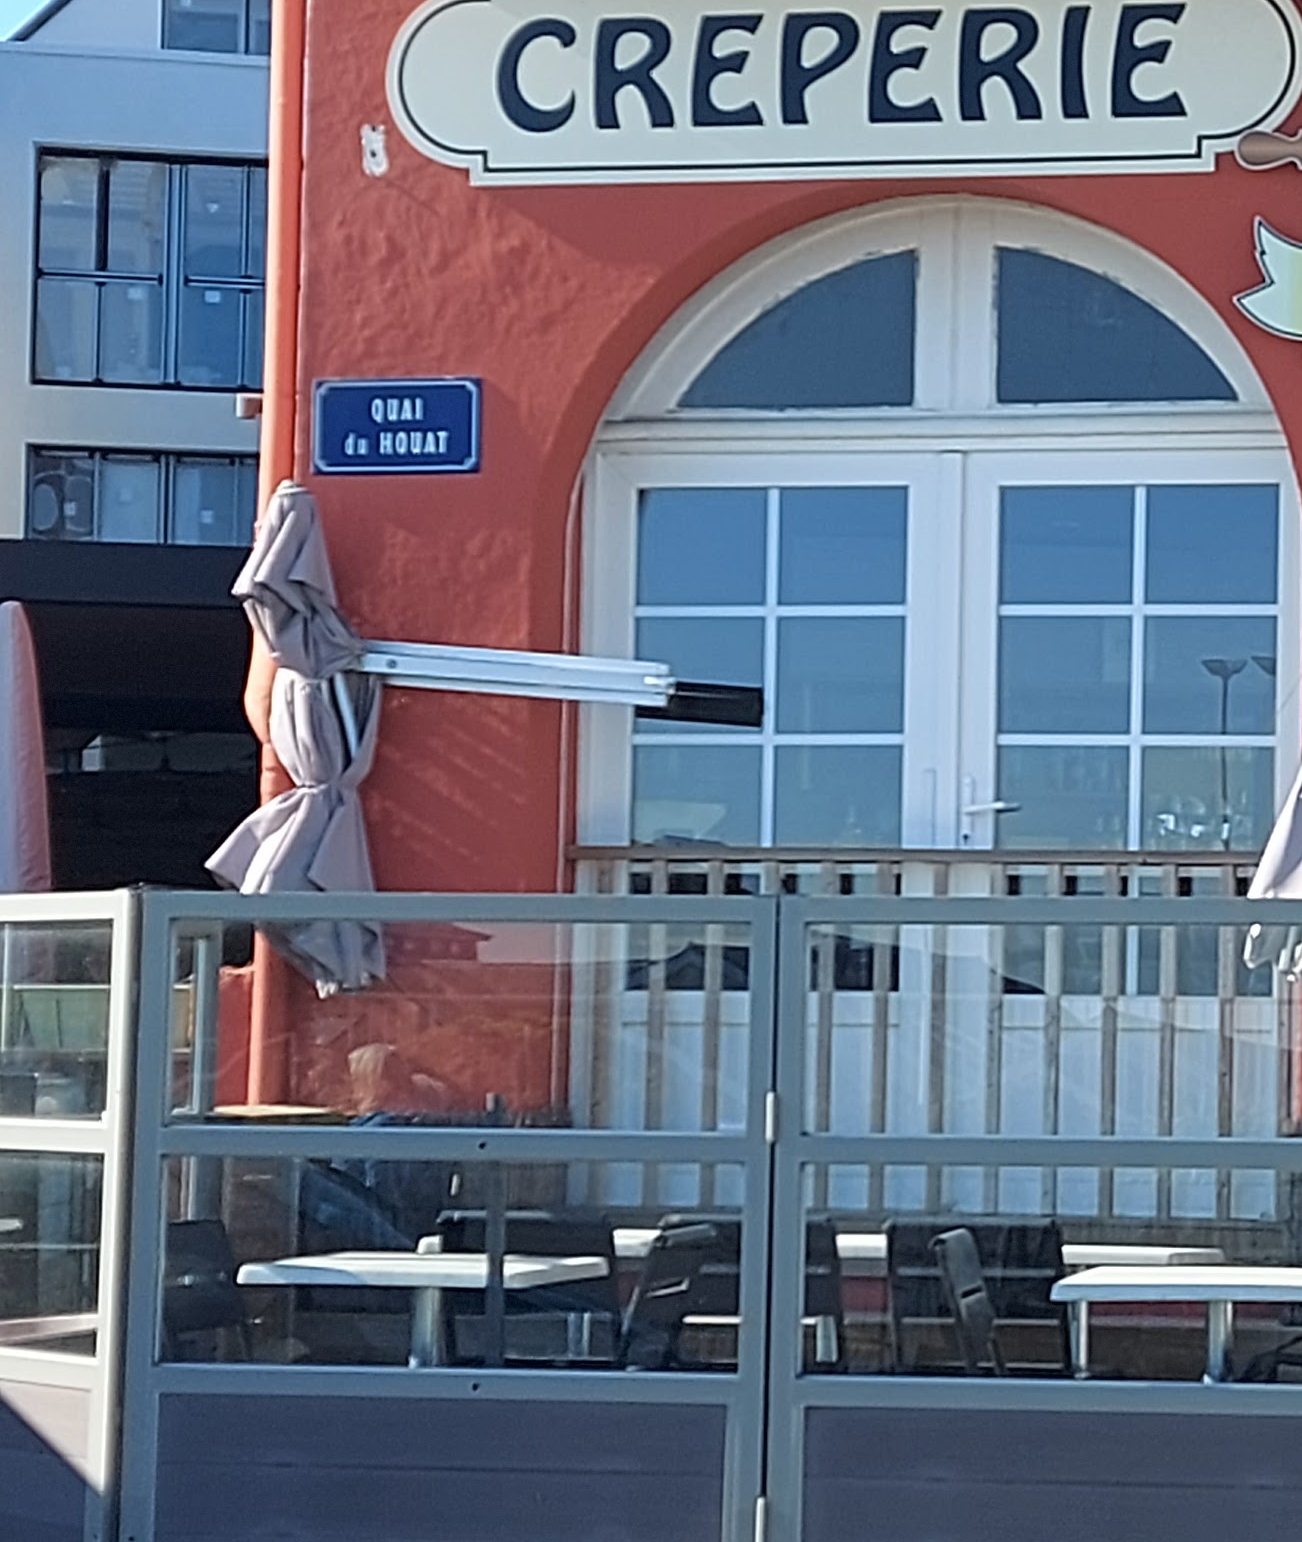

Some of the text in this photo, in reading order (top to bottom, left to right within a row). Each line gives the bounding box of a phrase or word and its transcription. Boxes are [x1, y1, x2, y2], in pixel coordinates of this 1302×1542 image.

[496, 1, 1189, 134] CREPERIE
[370, 397, 424, 424] QUAI
[344, 430, 449, 456] du HOUAT
